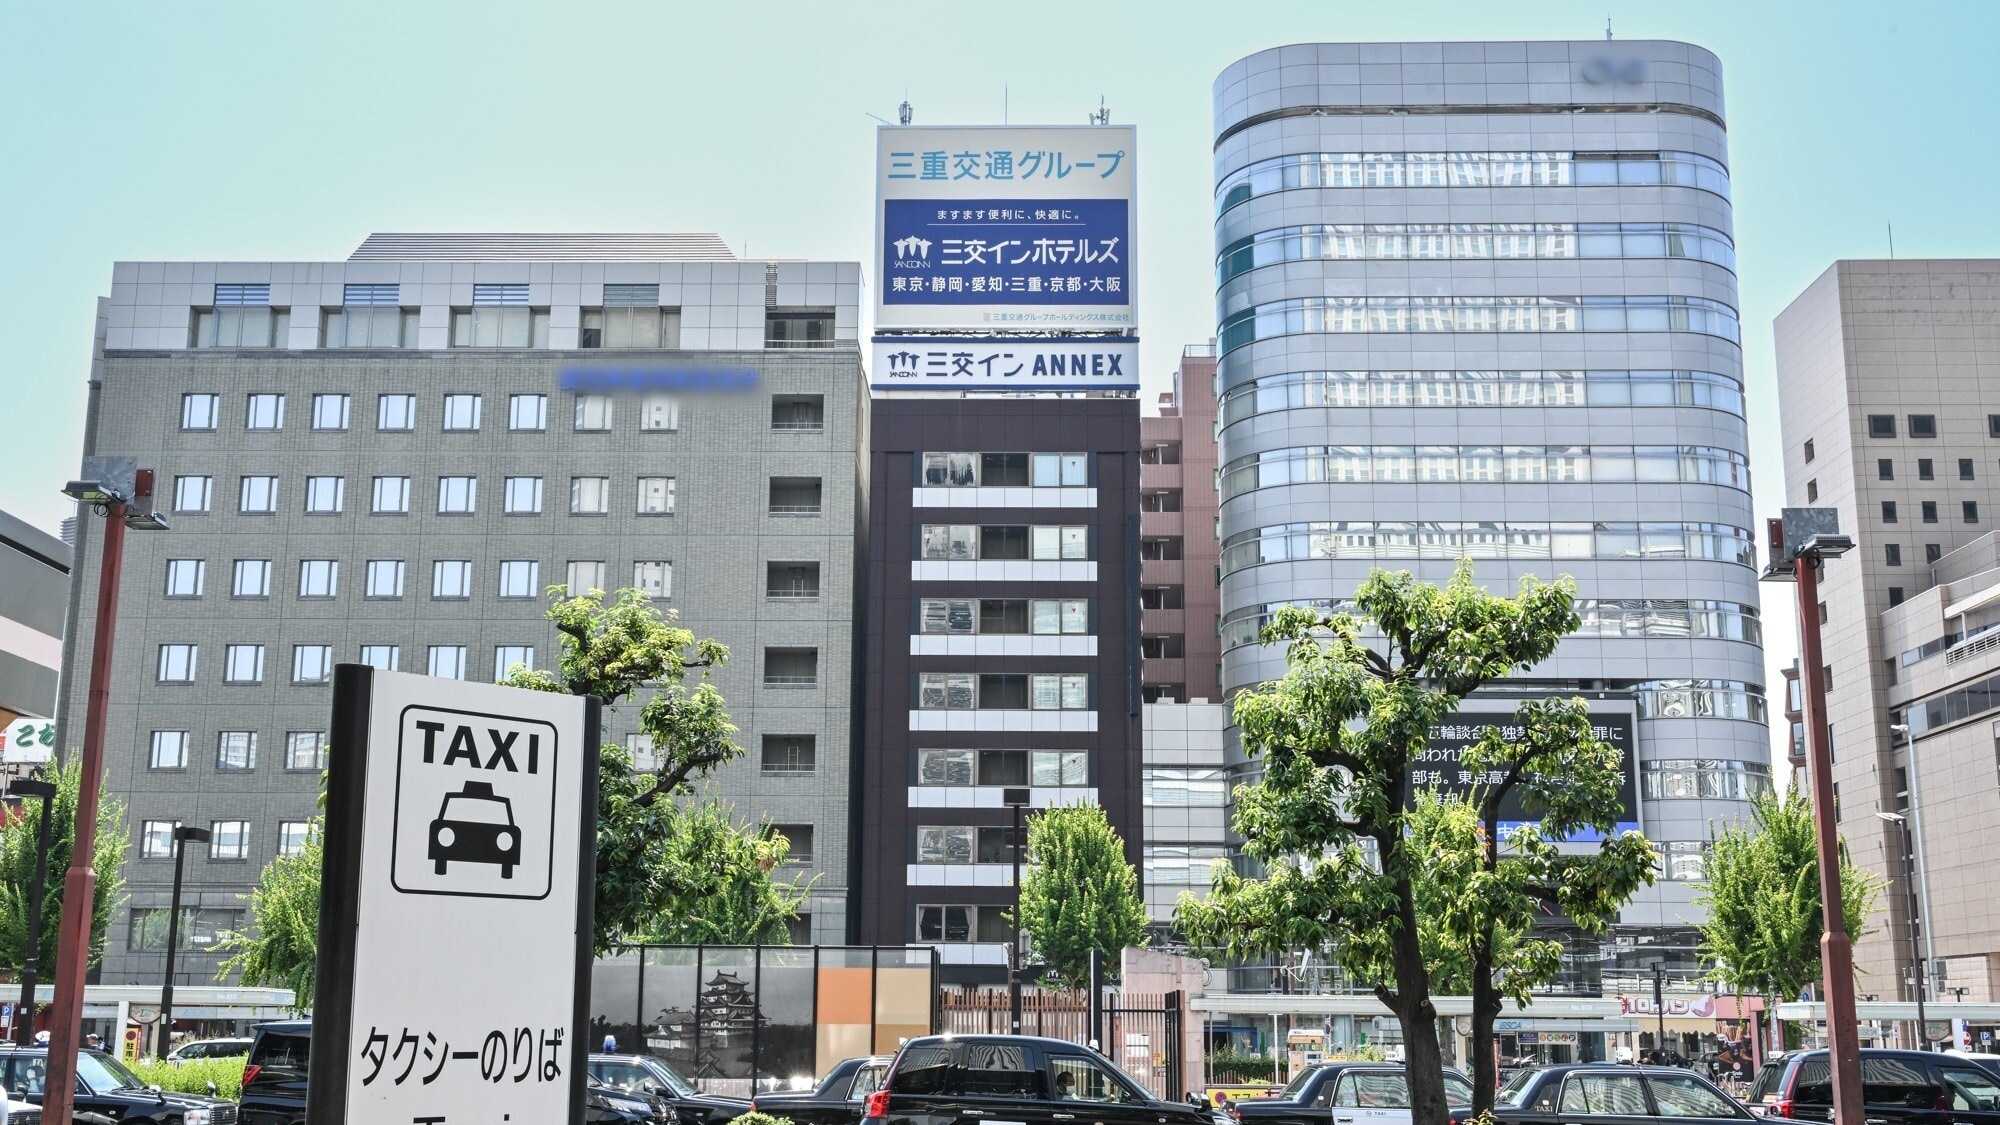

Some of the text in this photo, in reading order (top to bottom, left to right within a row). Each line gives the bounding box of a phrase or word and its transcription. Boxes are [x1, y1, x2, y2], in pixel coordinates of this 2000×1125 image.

[888, 150, 1125, 181] 三重交通グループ
[937, 209, 1080, 221] ますます便利に、快適に。
[941, 236, 1119, 265] 三交インホテルズ
[993, 312, 1129, 321] 三重交通グループホールディングス株式会社
[926, 351, 1123, 377] 三交イン ANNEX
[416, 719, 541, 775] TAXI
[360, 1026, 564, 1087] タクシーのりば
